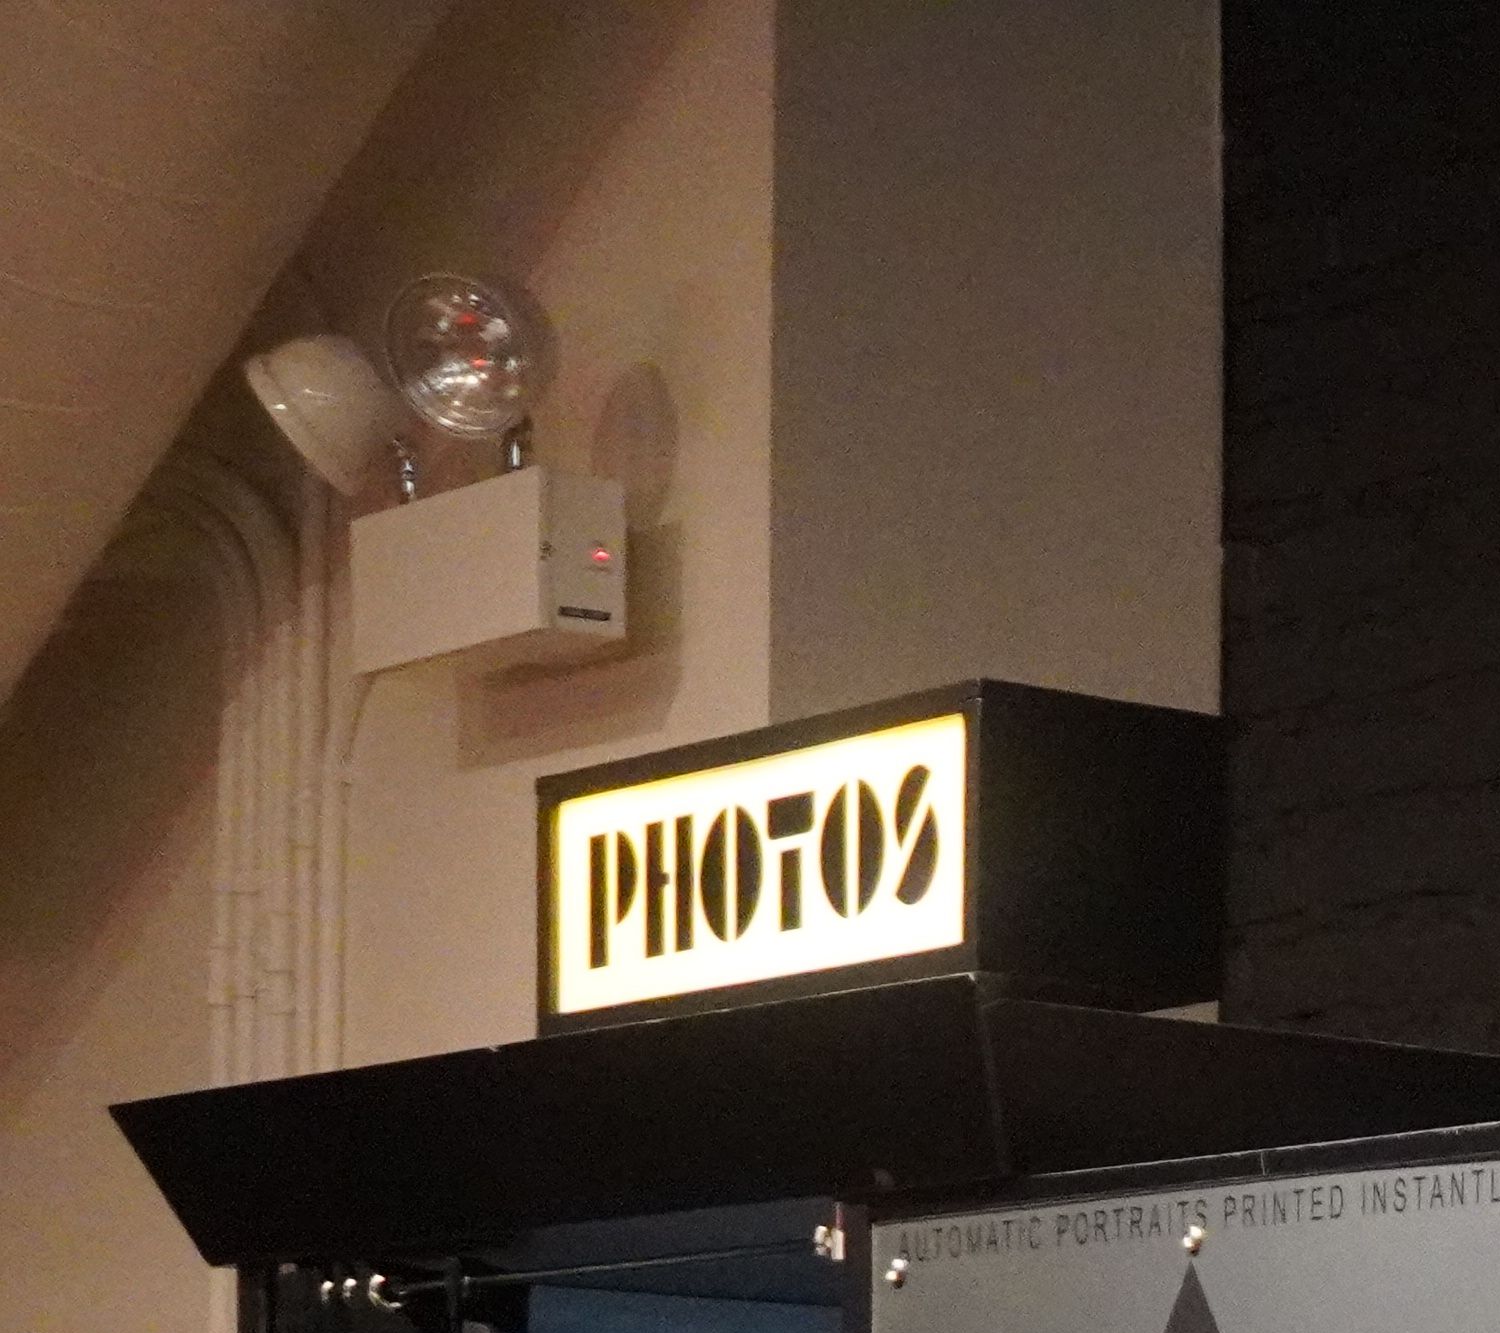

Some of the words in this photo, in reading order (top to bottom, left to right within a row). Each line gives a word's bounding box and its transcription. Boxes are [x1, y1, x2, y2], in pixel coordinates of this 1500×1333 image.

[589, 764, 940, 970] PHOTOS
[898, 1217, 1042, 1262] AUTOMATIC
[1056, 1203, 1208, 1247] PORTRAITS
[1223, 1184, 1345, 1226] PRINTED
